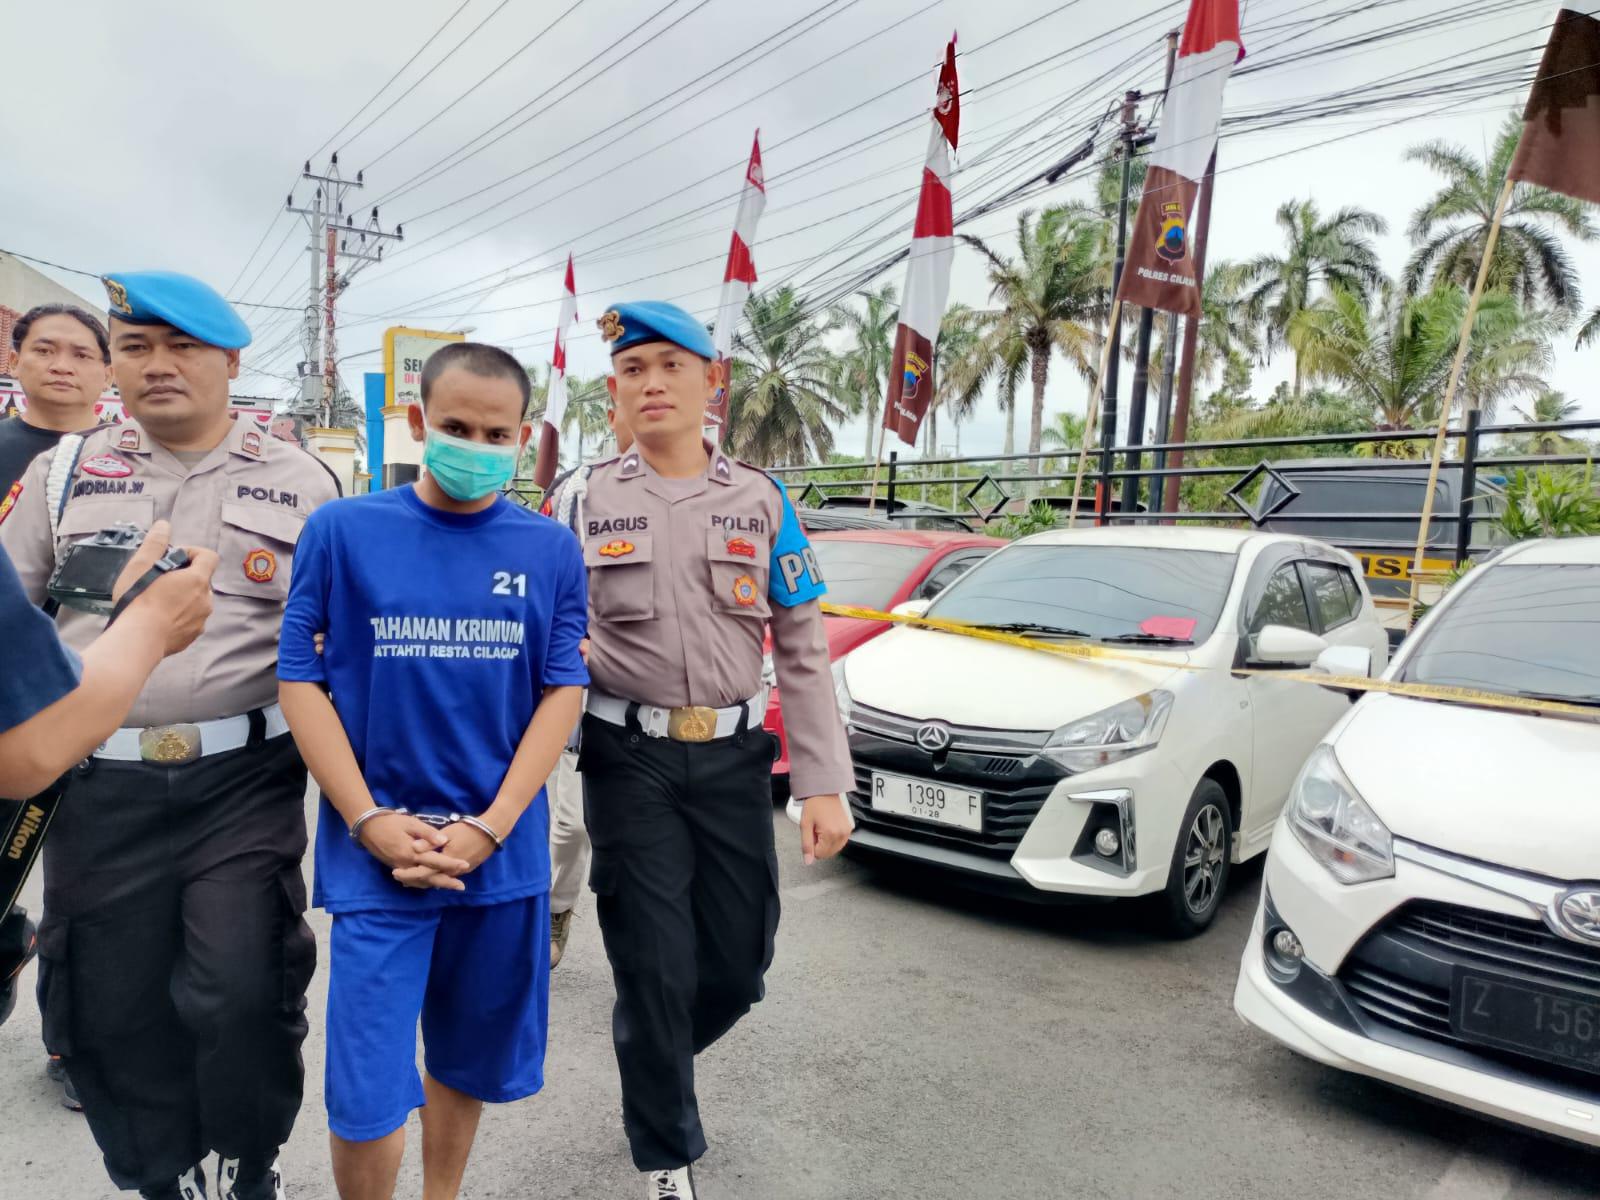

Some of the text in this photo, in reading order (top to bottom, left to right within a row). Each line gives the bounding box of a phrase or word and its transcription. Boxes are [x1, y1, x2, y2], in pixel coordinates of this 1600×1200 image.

[237, 485, 298, 508] POLRI
[588, 516, 648, 536] BAGUS
[711, 515, 764, 534] POLRI
[492, 571, 527, 597] 21
[370, 616, 524, 644] TAHANAN KRIMUM
[374, 645, 519, 660] ATTAHTI RESTA CILACAP
[875, 777, 977, 816] R 1399 F
[8, 803, 45, 859] Nikon
[1472, 982, 1600, 1042] Z 156
